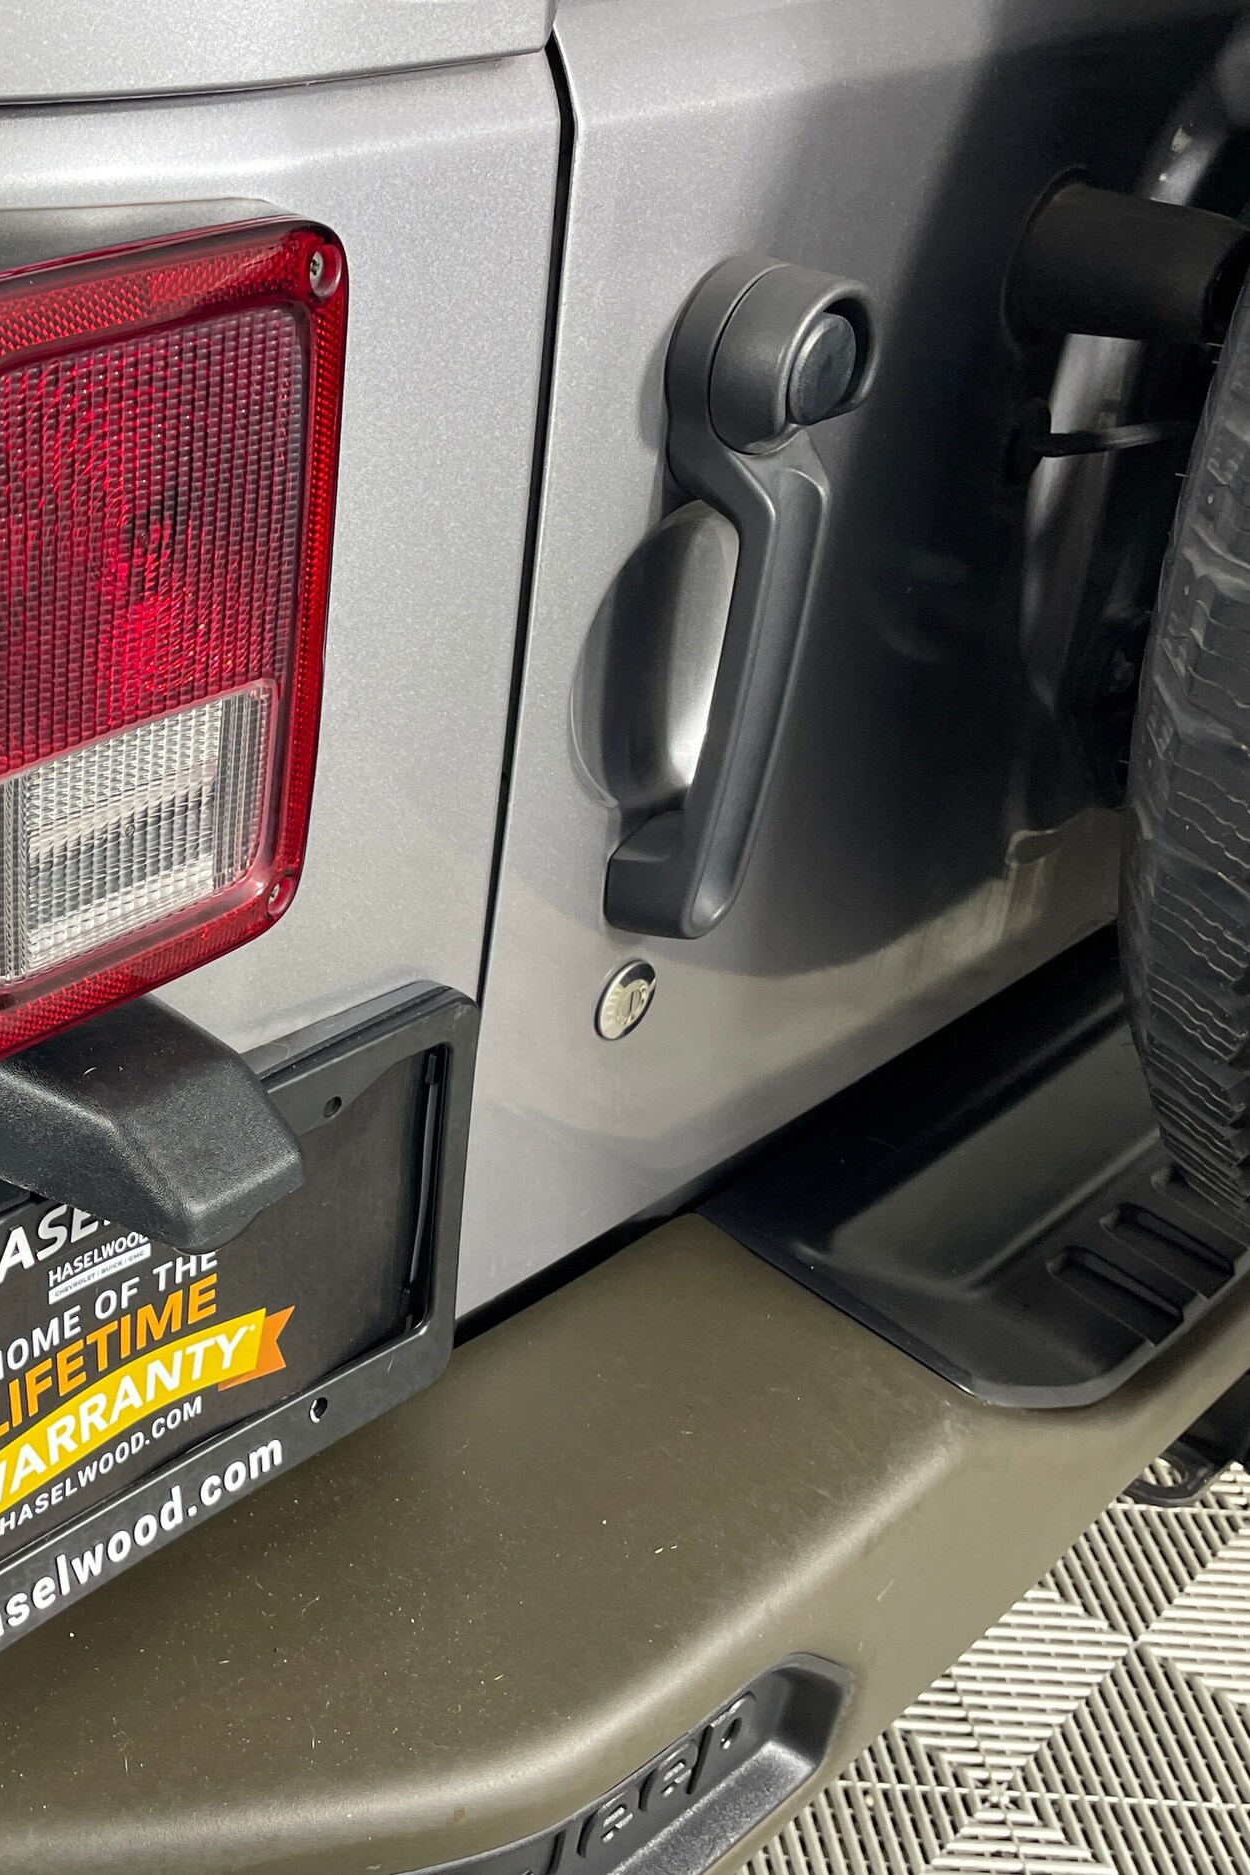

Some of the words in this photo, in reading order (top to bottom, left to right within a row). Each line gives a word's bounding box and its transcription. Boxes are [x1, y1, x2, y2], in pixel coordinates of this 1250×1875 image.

[54, 1273, 96, 1297] CHEVROLET
[101, 1260, 124, 1274] BUICK
[94, 1276, 141, 1321] OF
[152, 1251, 219, 1293] THE
